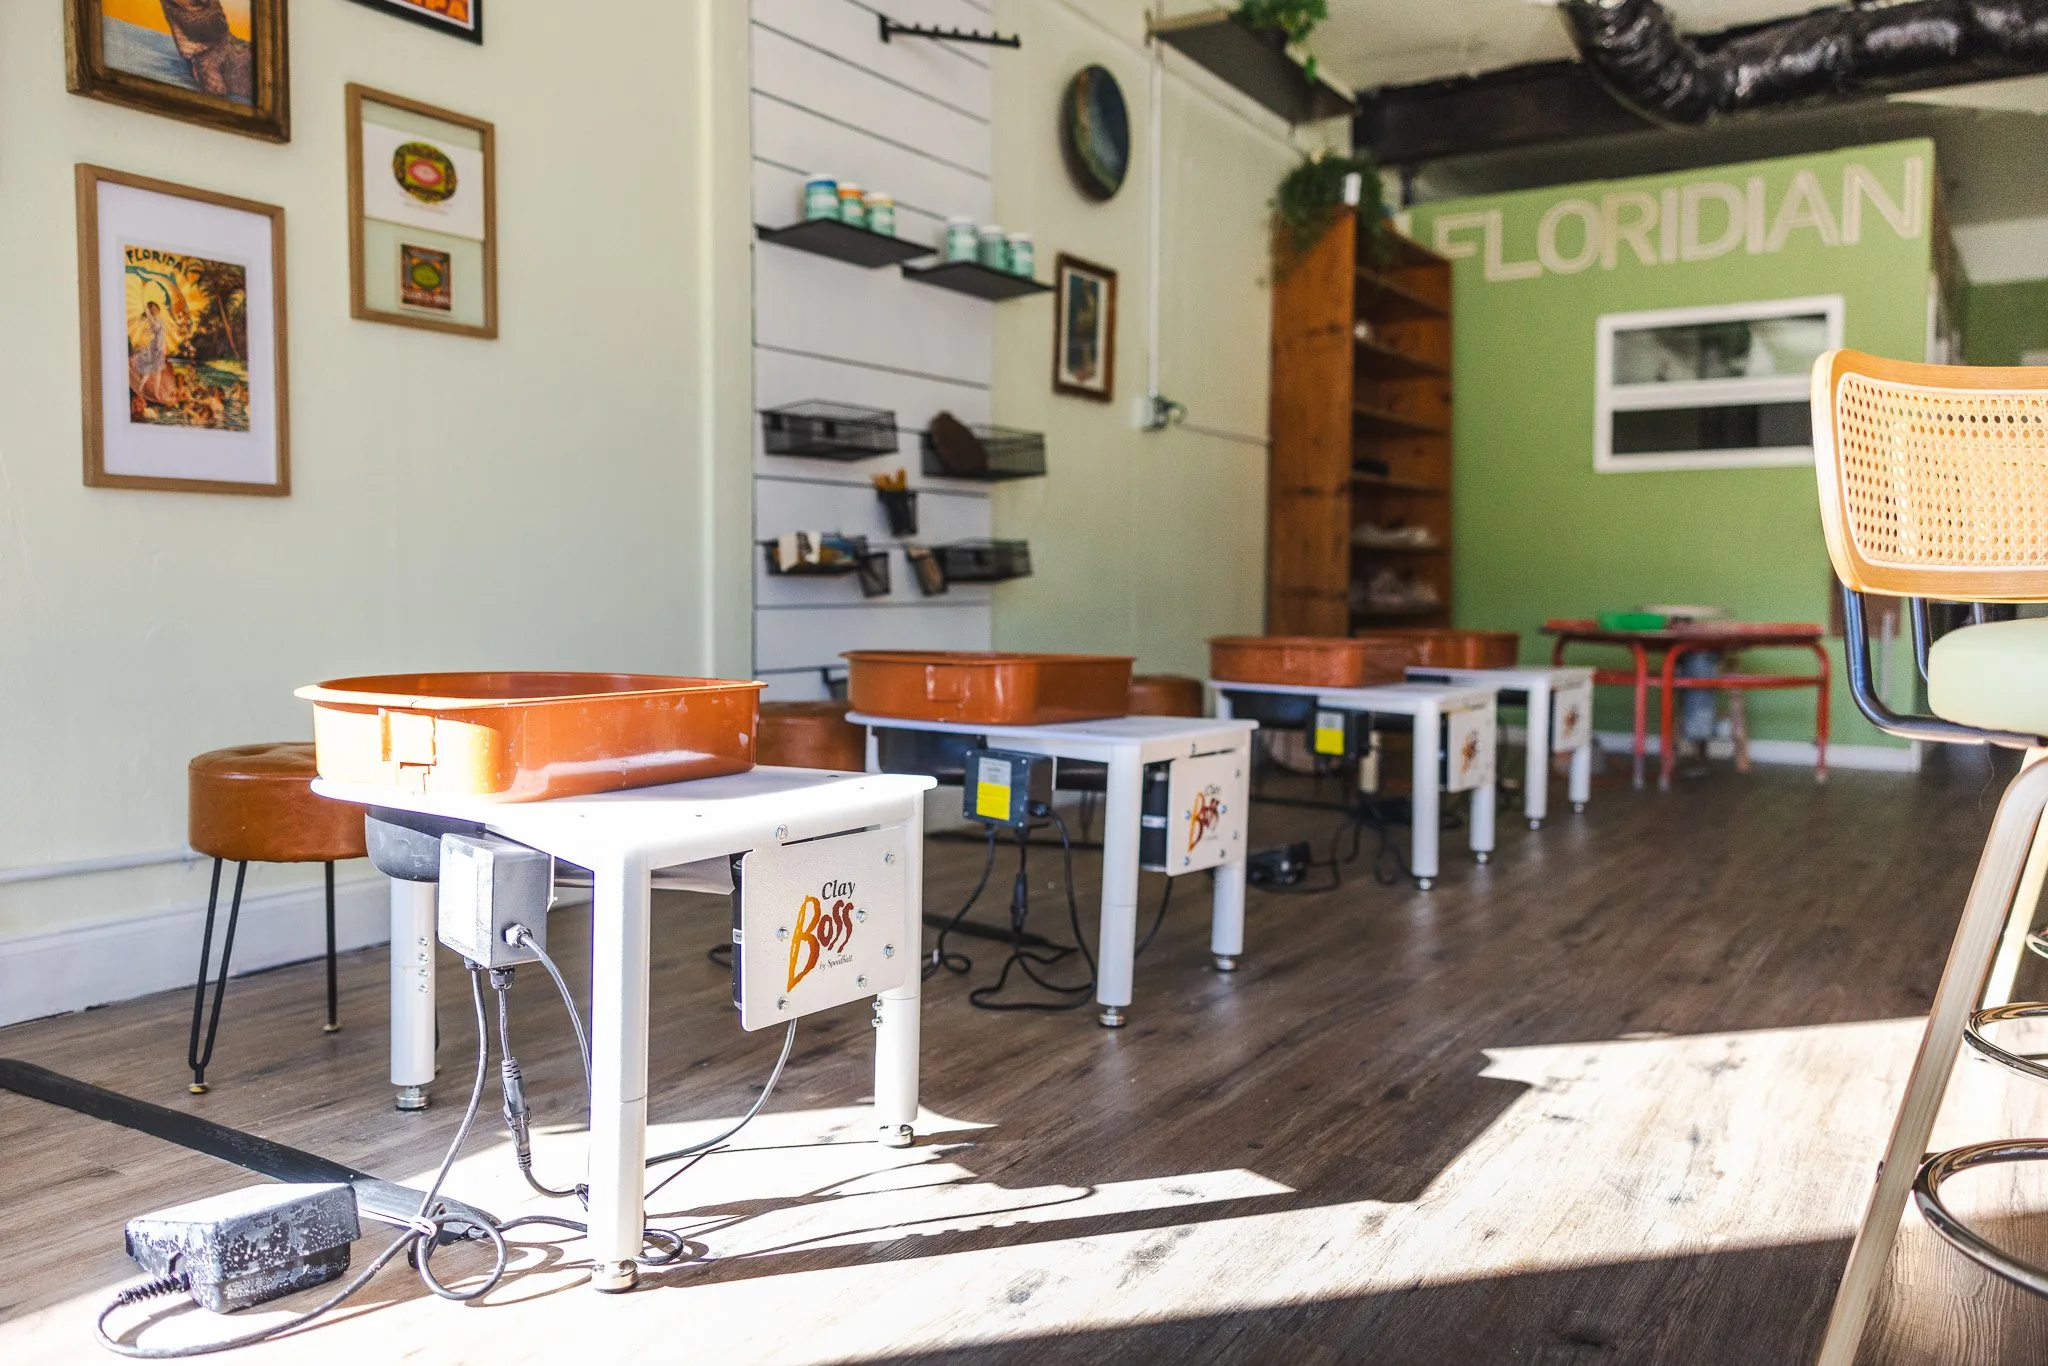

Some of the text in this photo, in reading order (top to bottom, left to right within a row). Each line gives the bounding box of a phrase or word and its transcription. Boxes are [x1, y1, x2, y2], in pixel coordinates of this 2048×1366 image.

[1432, 155, 1924, 282] FLORIDIAN
[125, 249, 183, 273] FLORIDA
[822, 879, 856, 900] Clay
